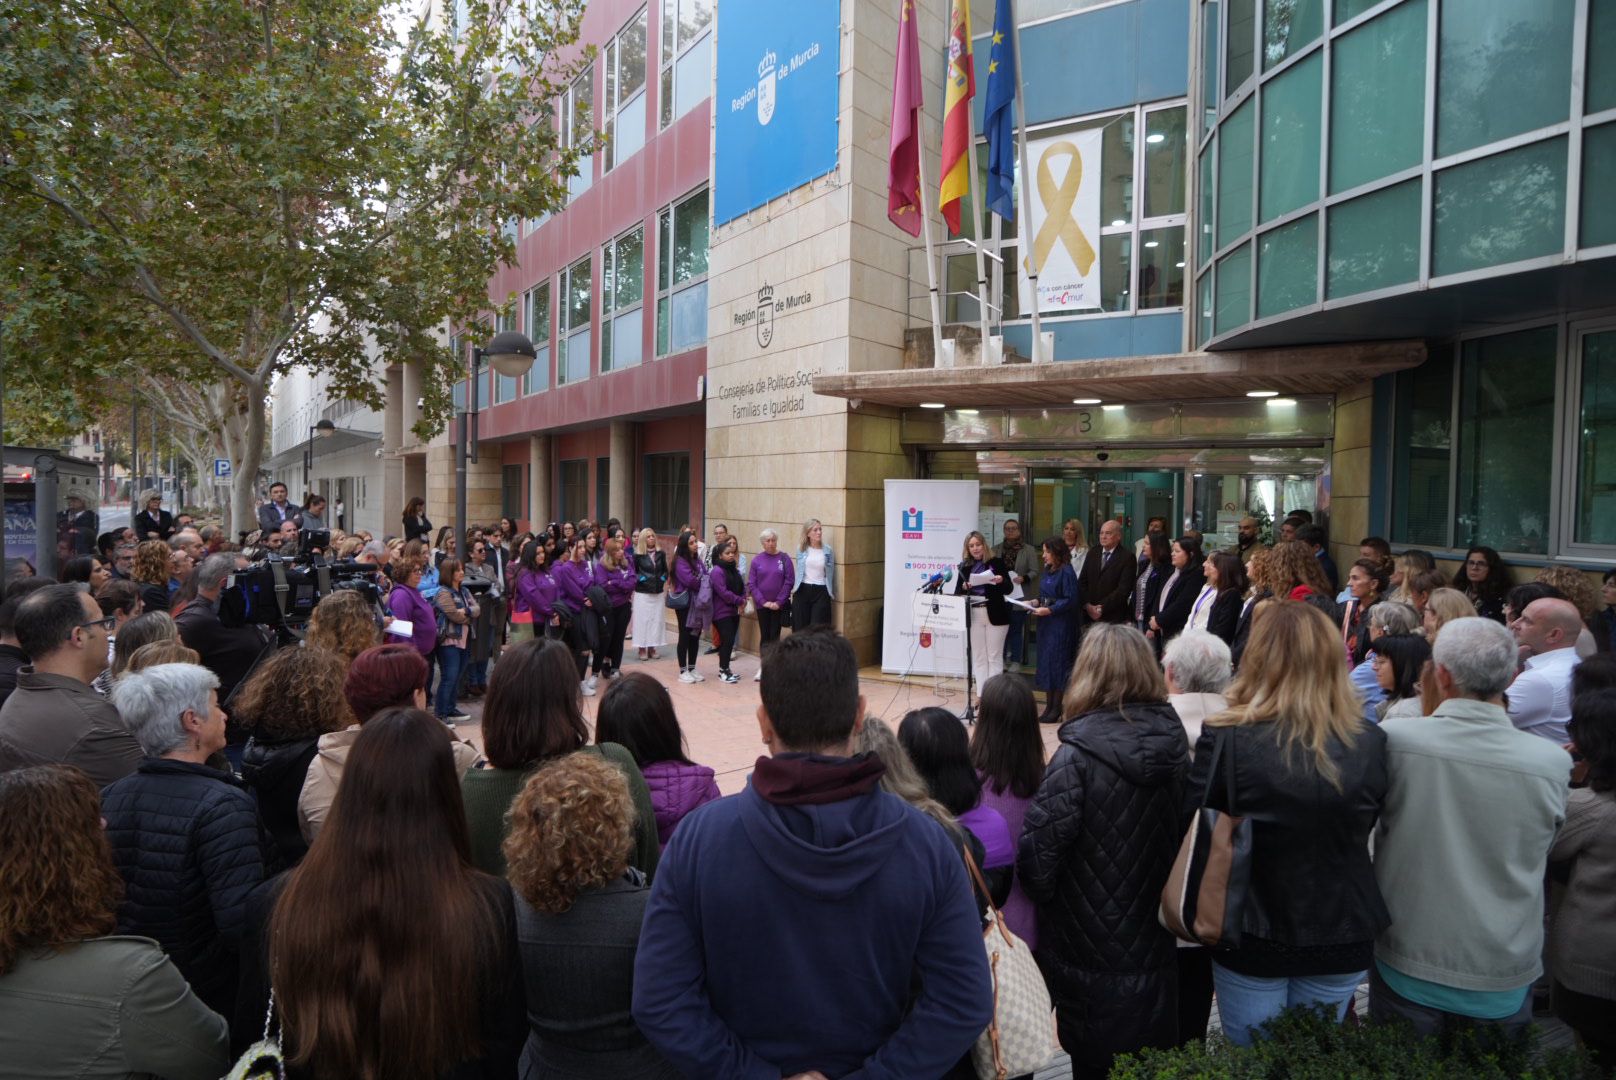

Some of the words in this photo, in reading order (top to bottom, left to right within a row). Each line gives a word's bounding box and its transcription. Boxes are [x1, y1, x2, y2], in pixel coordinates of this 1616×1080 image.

[731, 87, 756, 112] Región
[777, 63, 789, 80] de
[789, 42, 819, 72] Murcia
[734, 308, 756, 327] Región
[774, 299, 784, 313] de
[785, 290, 812, 310] Murcia
[719, 380, 755, 401] Consejería
[755, 378, 766, 393] de
[767, 373, 795, 392] Política
[732, 401, 761, 420] Familias
[762, 403, 768, 416] e
[769, 393, 805, 419] Igualdad
[1079, 412, 1092, 433] 3
[912, 562, 927, 570] 900
